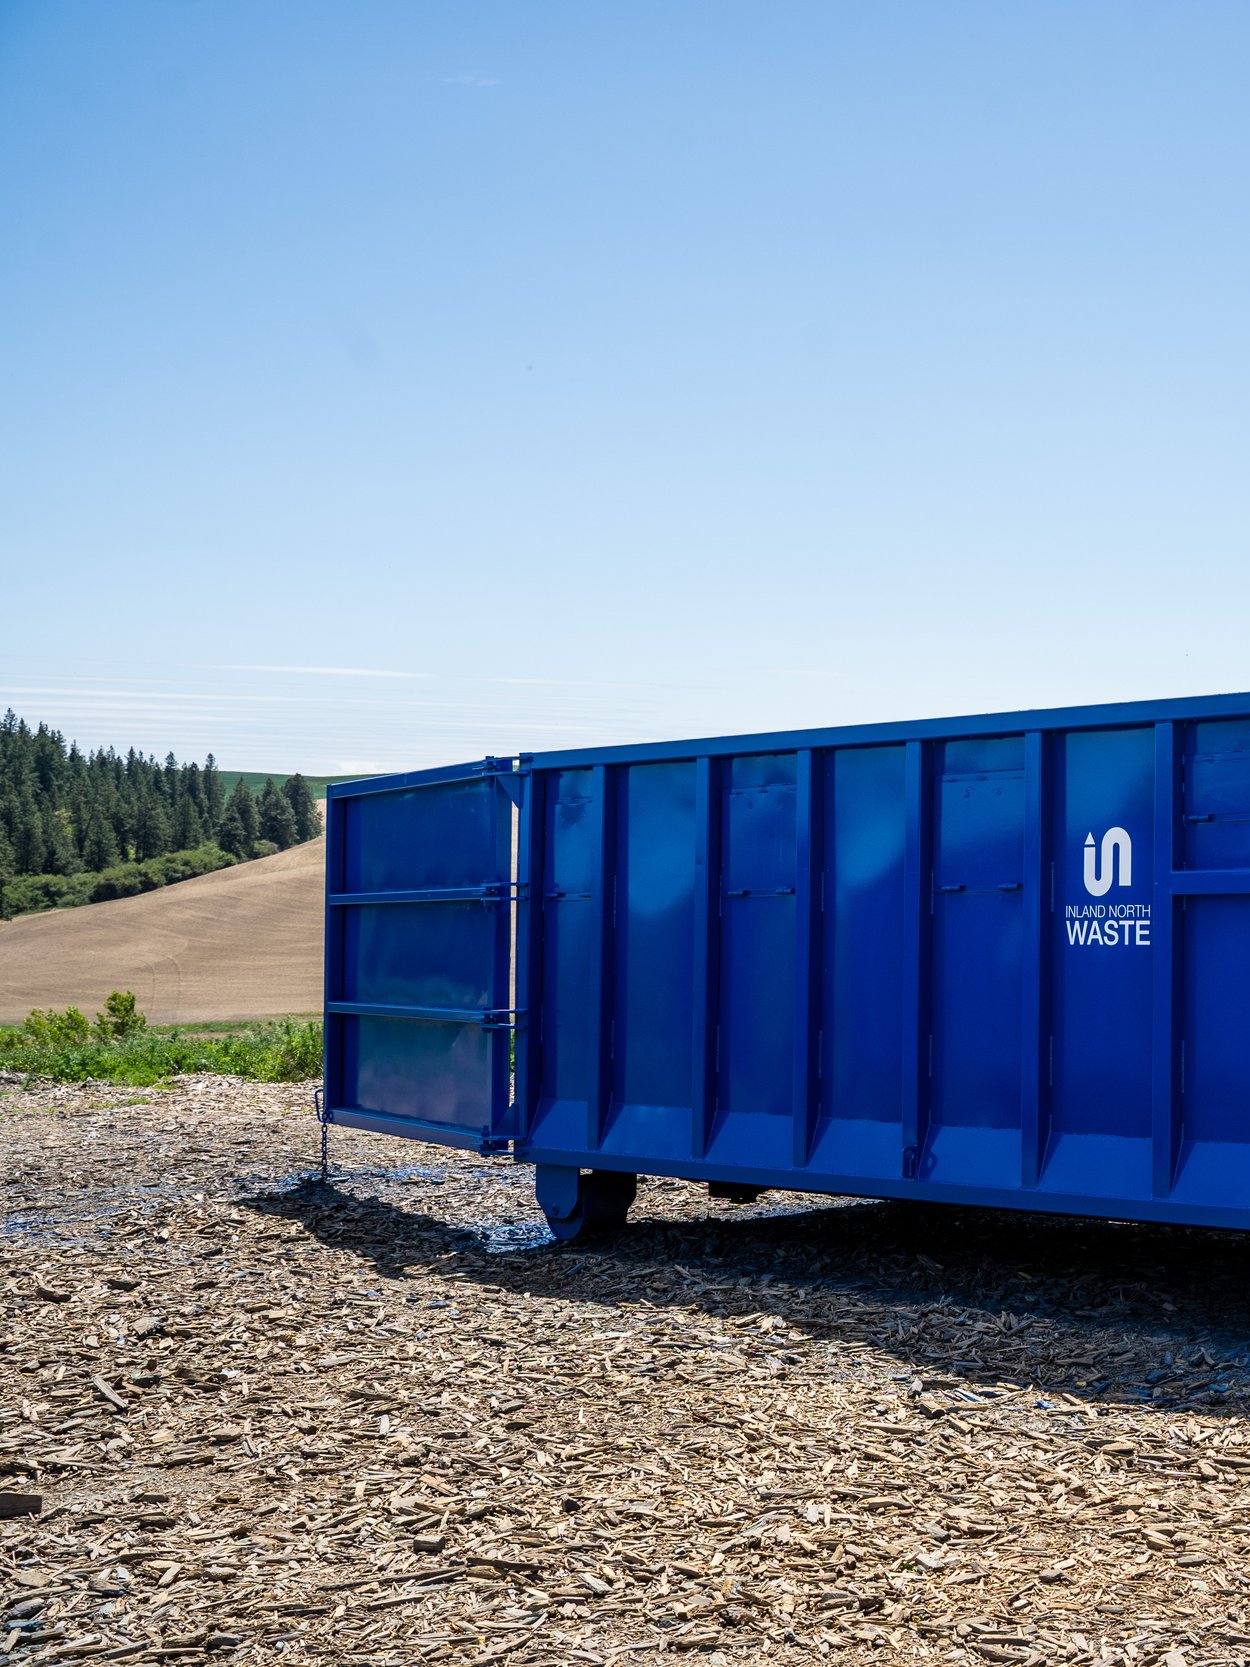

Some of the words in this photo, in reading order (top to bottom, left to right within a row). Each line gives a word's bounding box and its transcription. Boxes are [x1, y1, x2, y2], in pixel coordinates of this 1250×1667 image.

[1065, 904, 1106, 918] INLAND
[1108, 904, 1151, 918] NORTH
[1066, 919, 1151, 946] WASTE
